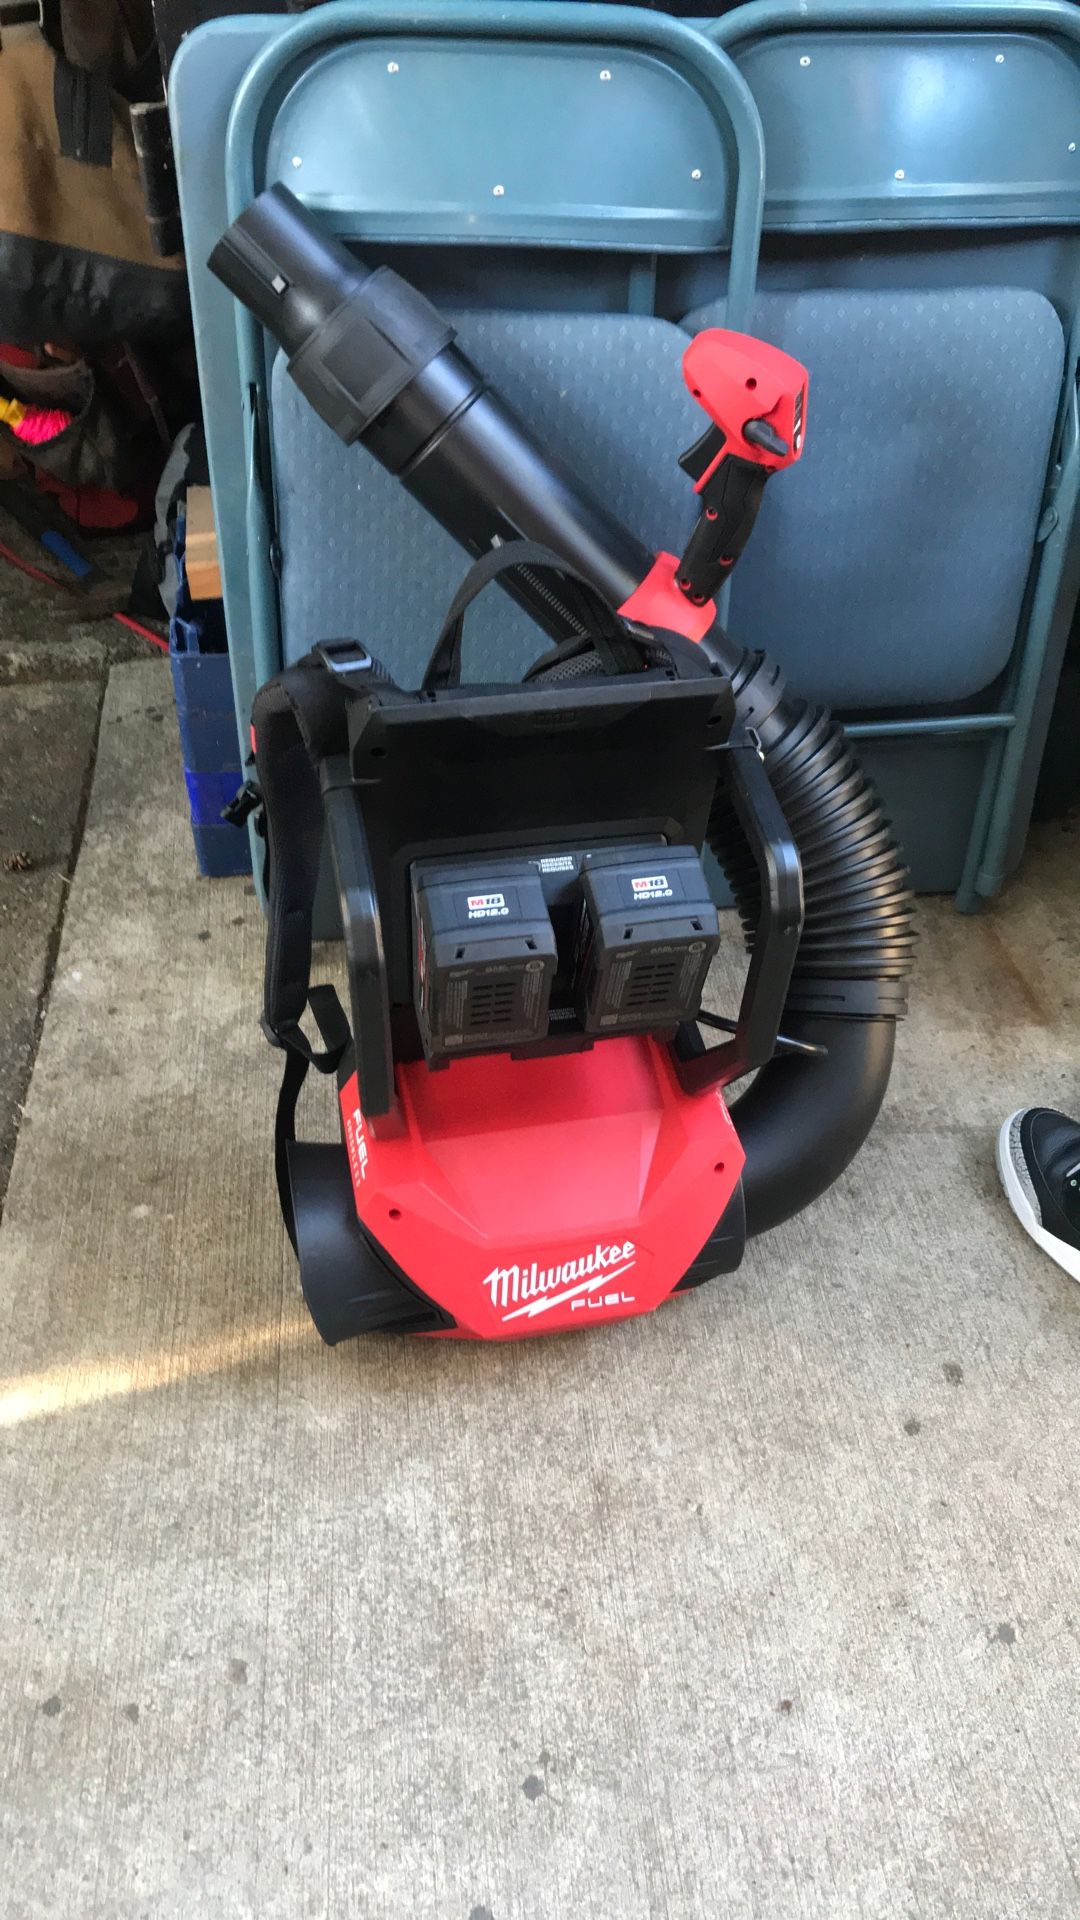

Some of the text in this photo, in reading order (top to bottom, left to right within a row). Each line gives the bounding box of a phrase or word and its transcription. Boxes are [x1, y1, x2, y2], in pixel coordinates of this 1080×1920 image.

[633, 877, 666, 890] M18
[633, 888, 673, 901] HD12.0
[469, 896, 503, 908] M18
[468, 907, 509, 919] HD12.0
[353, 1108, 368, 1180] FUEL
[482, 1240, 636, 1308] Milwaukee
[571, 1291, 635, 1312] FUEL
